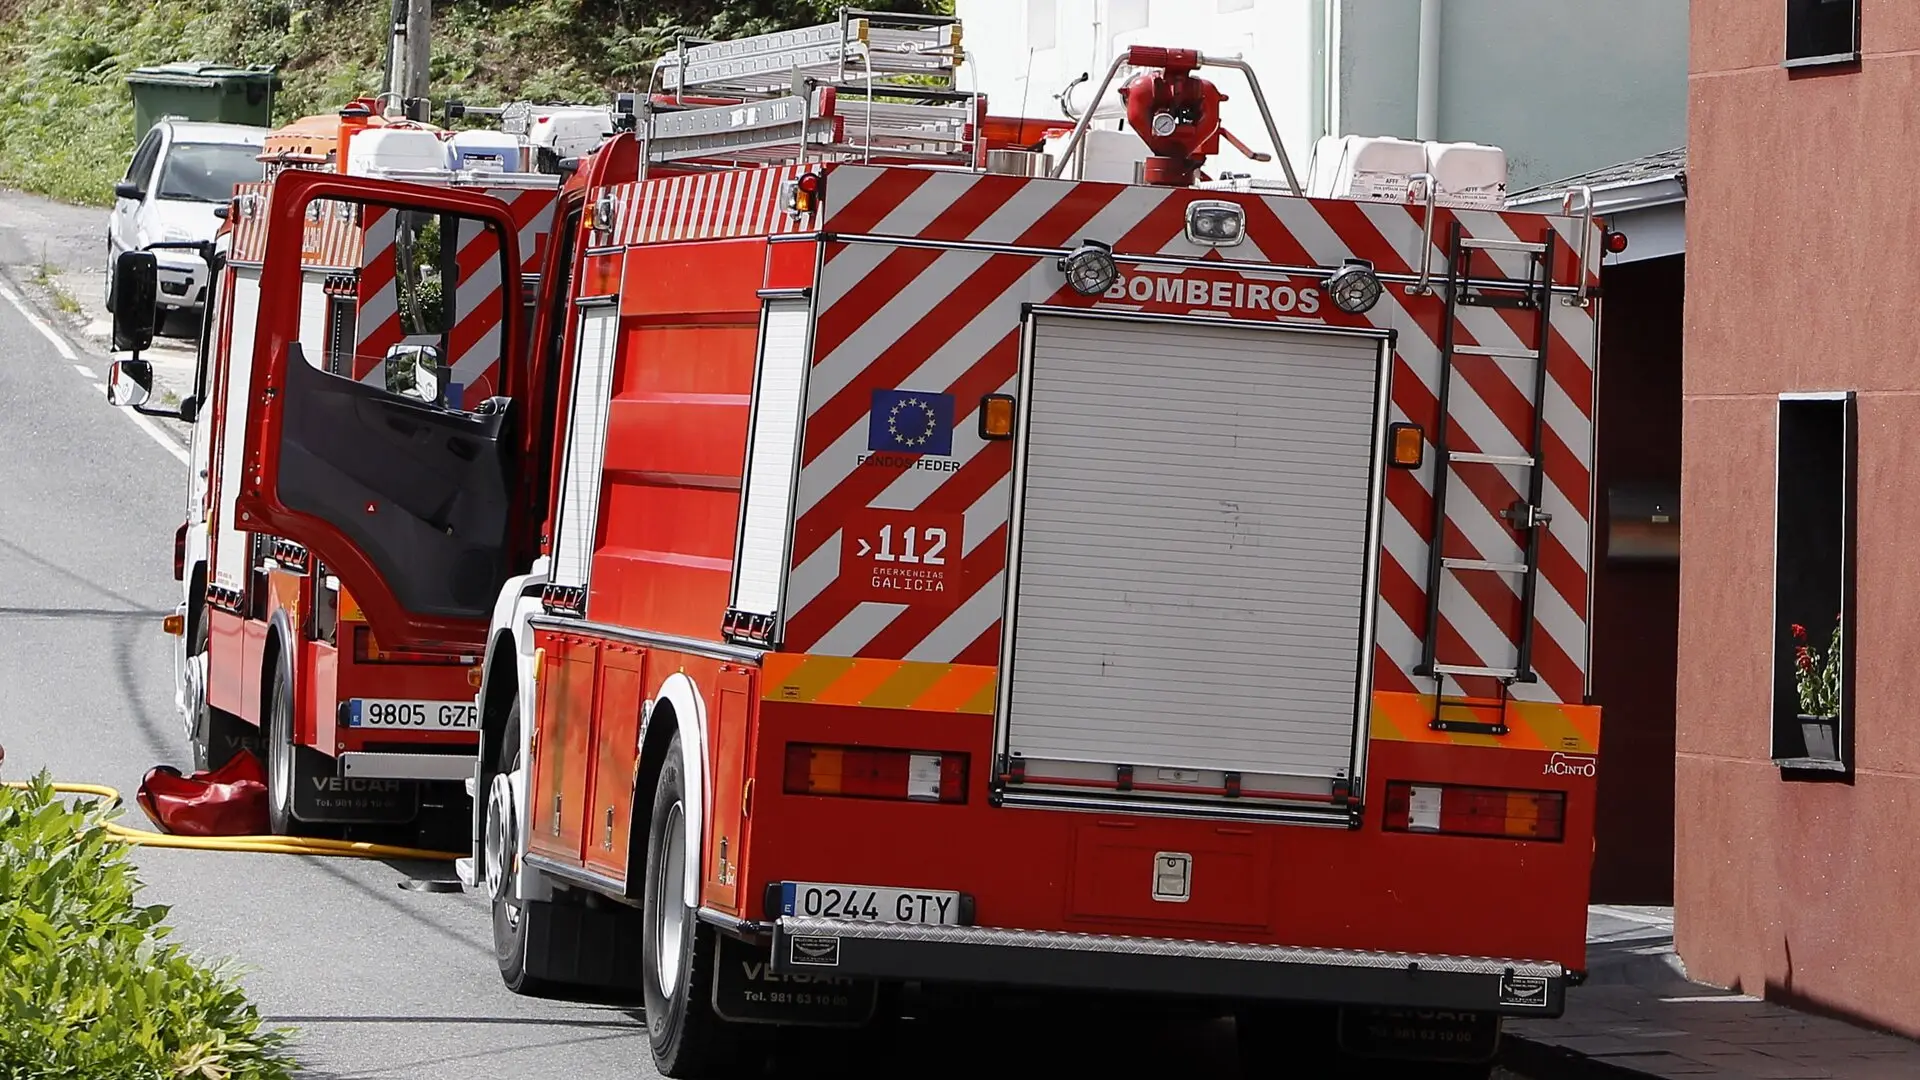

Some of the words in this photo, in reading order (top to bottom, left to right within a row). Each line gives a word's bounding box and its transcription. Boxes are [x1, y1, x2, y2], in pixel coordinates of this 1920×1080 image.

[1104, 275, 1320, 313] BOMBEIROS
[857, 455, 913, 468] FONDOS
[916, 459, 961, 472] FEDER
[873, 567, 944, 579] EMERXENCIAS
[872, 576, 944, 592] GALICIA
[352, 715, 359, 723] E
[369, 703, 426, 726] 9805
[438, 704, 478, 728] GZR
[784, 904, 791, 913] E
[804, 888, 879, 920] 0244
[895, 894, 952, 924] GTY
[744, 991, 767, 1001] Tel.
[770, 992, 793, 1003] 981
